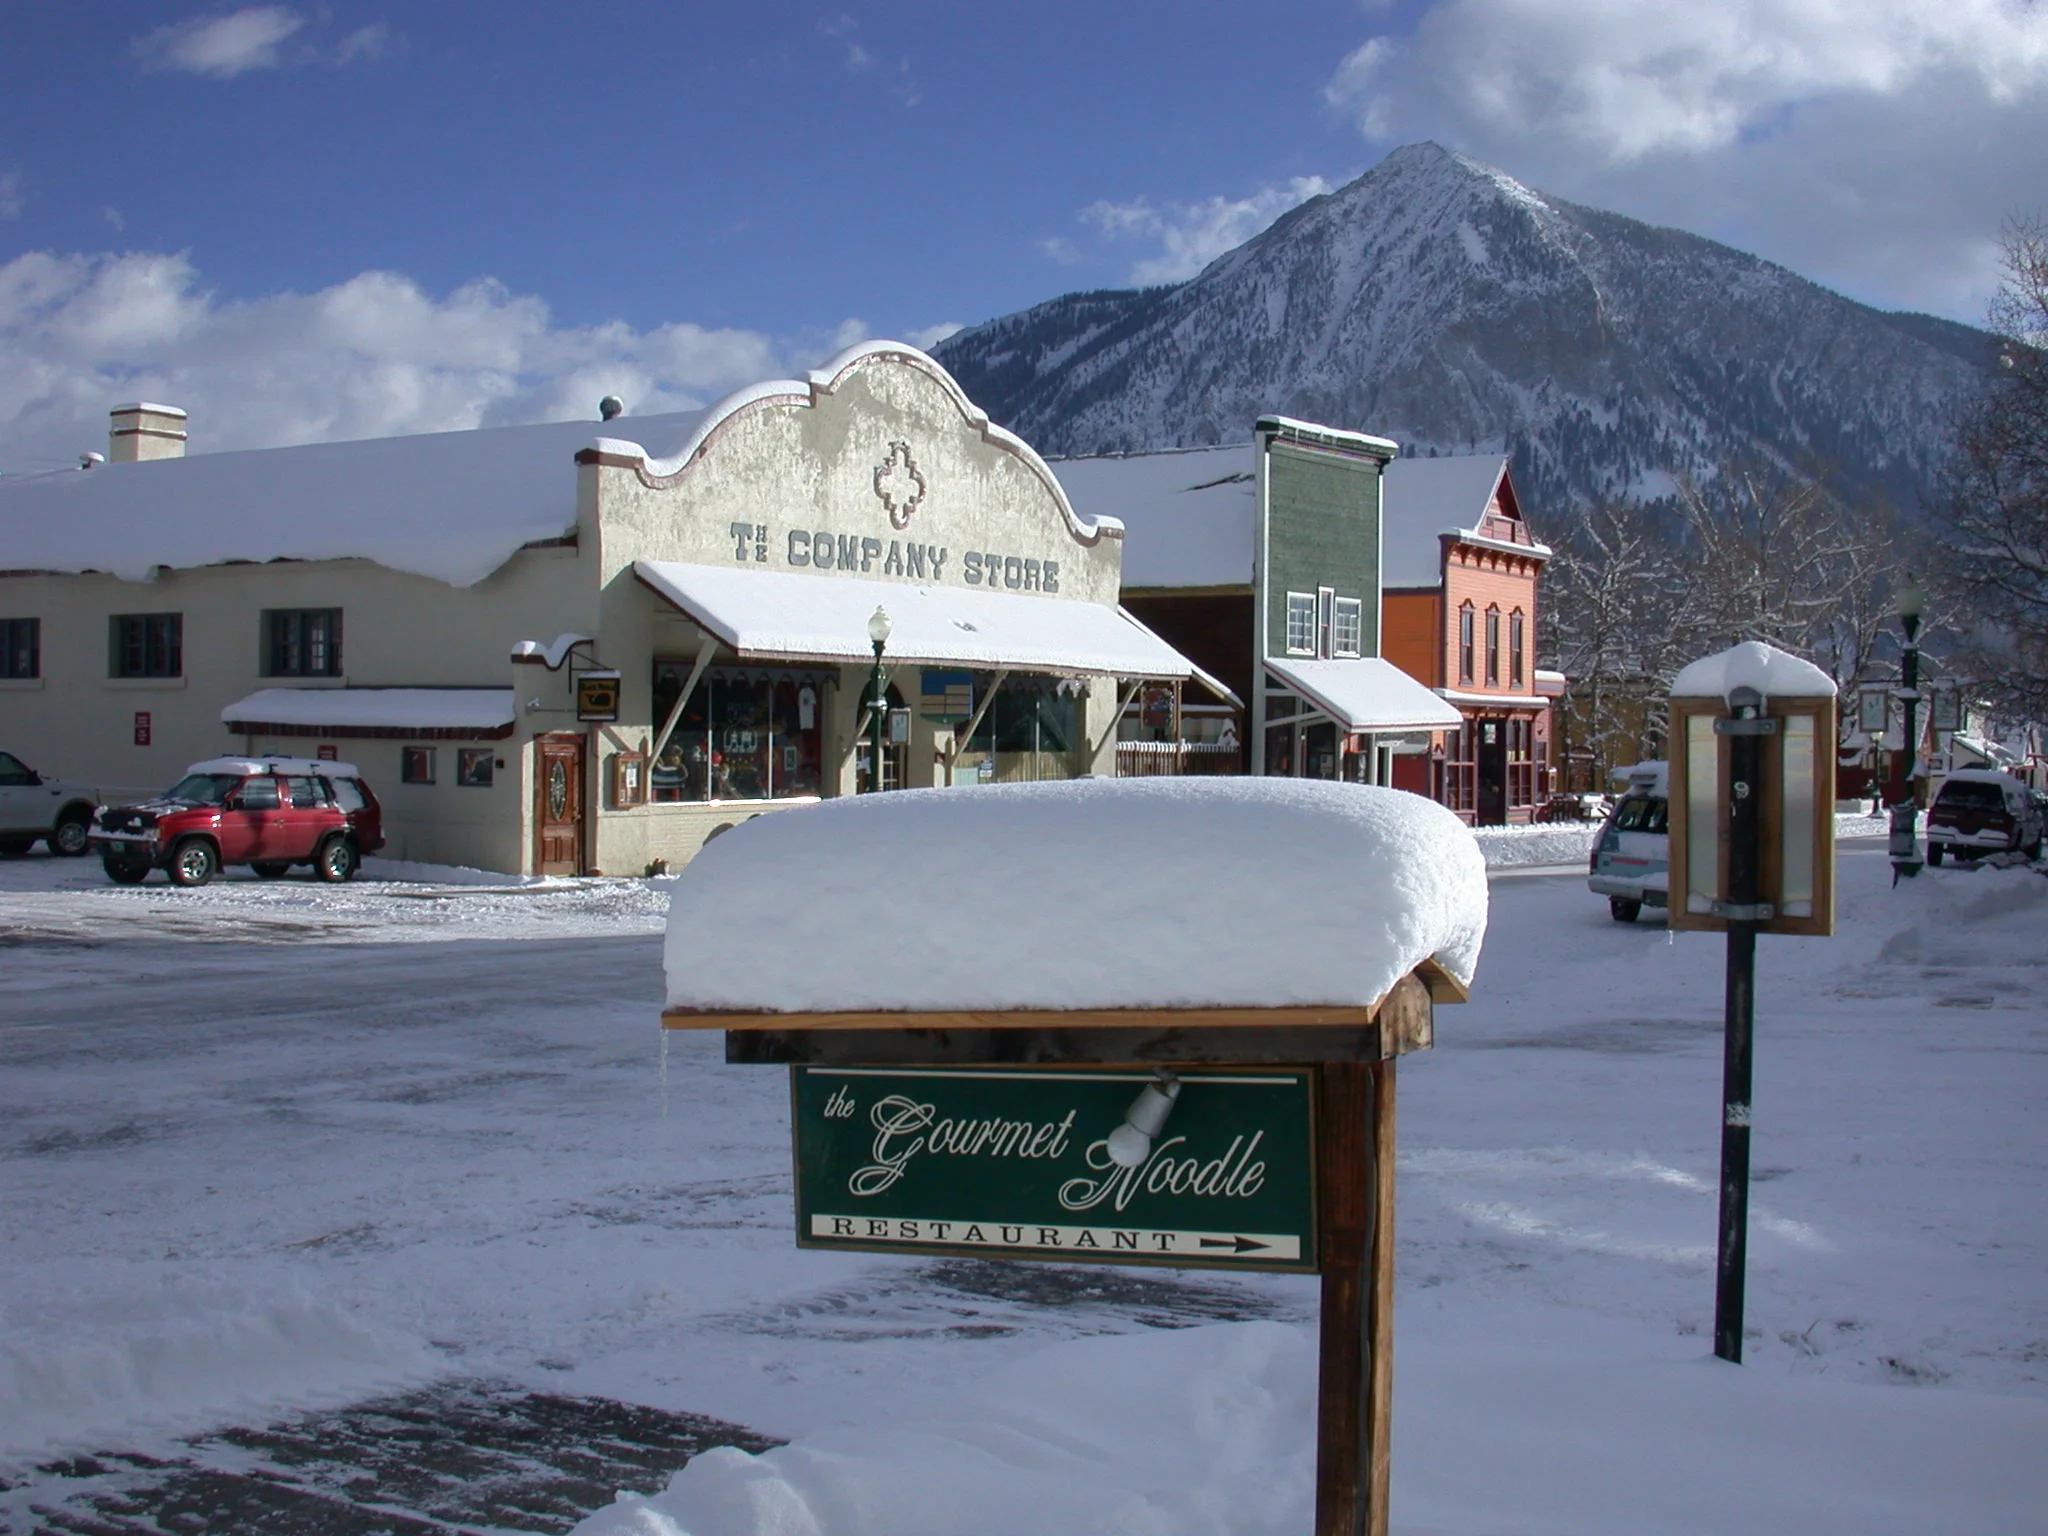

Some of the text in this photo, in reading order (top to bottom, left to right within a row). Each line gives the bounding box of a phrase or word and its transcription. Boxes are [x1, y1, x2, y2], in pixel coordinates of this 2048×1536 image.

[788, 529, 947, 581] COMPANY
[964, 550, 1059, 593] STORE
[824, 1085, 1265, 1211] the Gourmet Noodle
[831, 1216, 1177, 1252] RESTAURANT
